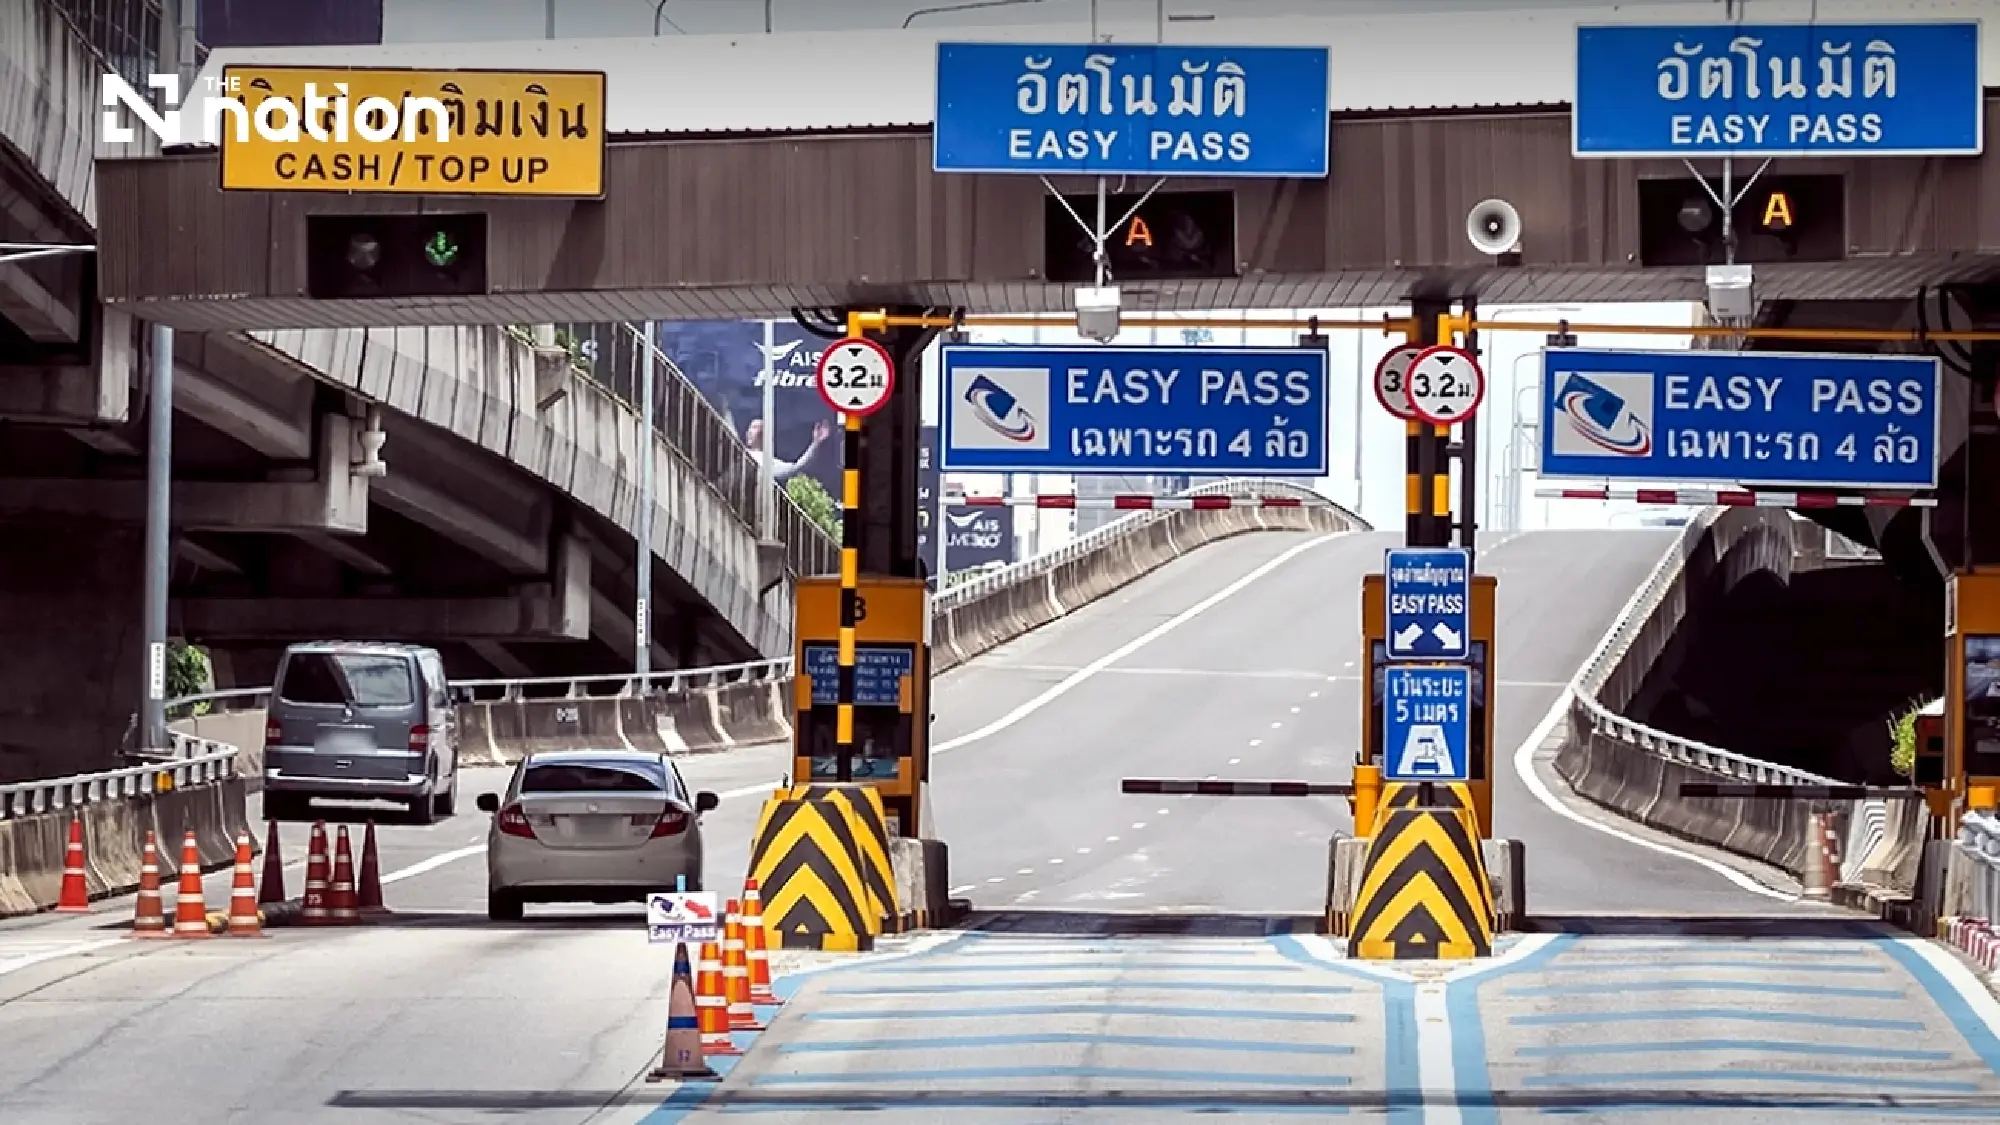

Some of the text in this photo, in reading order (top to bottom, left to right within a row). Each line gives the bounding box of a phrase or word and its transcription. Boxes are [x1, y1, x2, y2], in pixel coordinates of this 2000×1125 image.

[1657, 36, 1896, 100] อัตโนมัติ
[1017, 53, 1246, 118] อัตโนมัติ
[1009, 129, 1250, 161] EASY PASS
[1671, 113, 1882, 144] EASY PASS
[502, 156, 548, 184] UP
[1762, 193, 1792, 226] A
[1125, 216, 1153, 247] A
[1067, 368, 1311, 406] EASY PASS
[1664, 375, 1923, 415] EASY PASS
[1071, 415, 1309, 458] เฉพาะรถ 4 ล้อ
[1667, 423, 1919, 464] เฉพาะรถ 4 ล้อ
[1391, 593, 1463, 614] EASY PASS
[1395, 698, 1409, 723] 5
